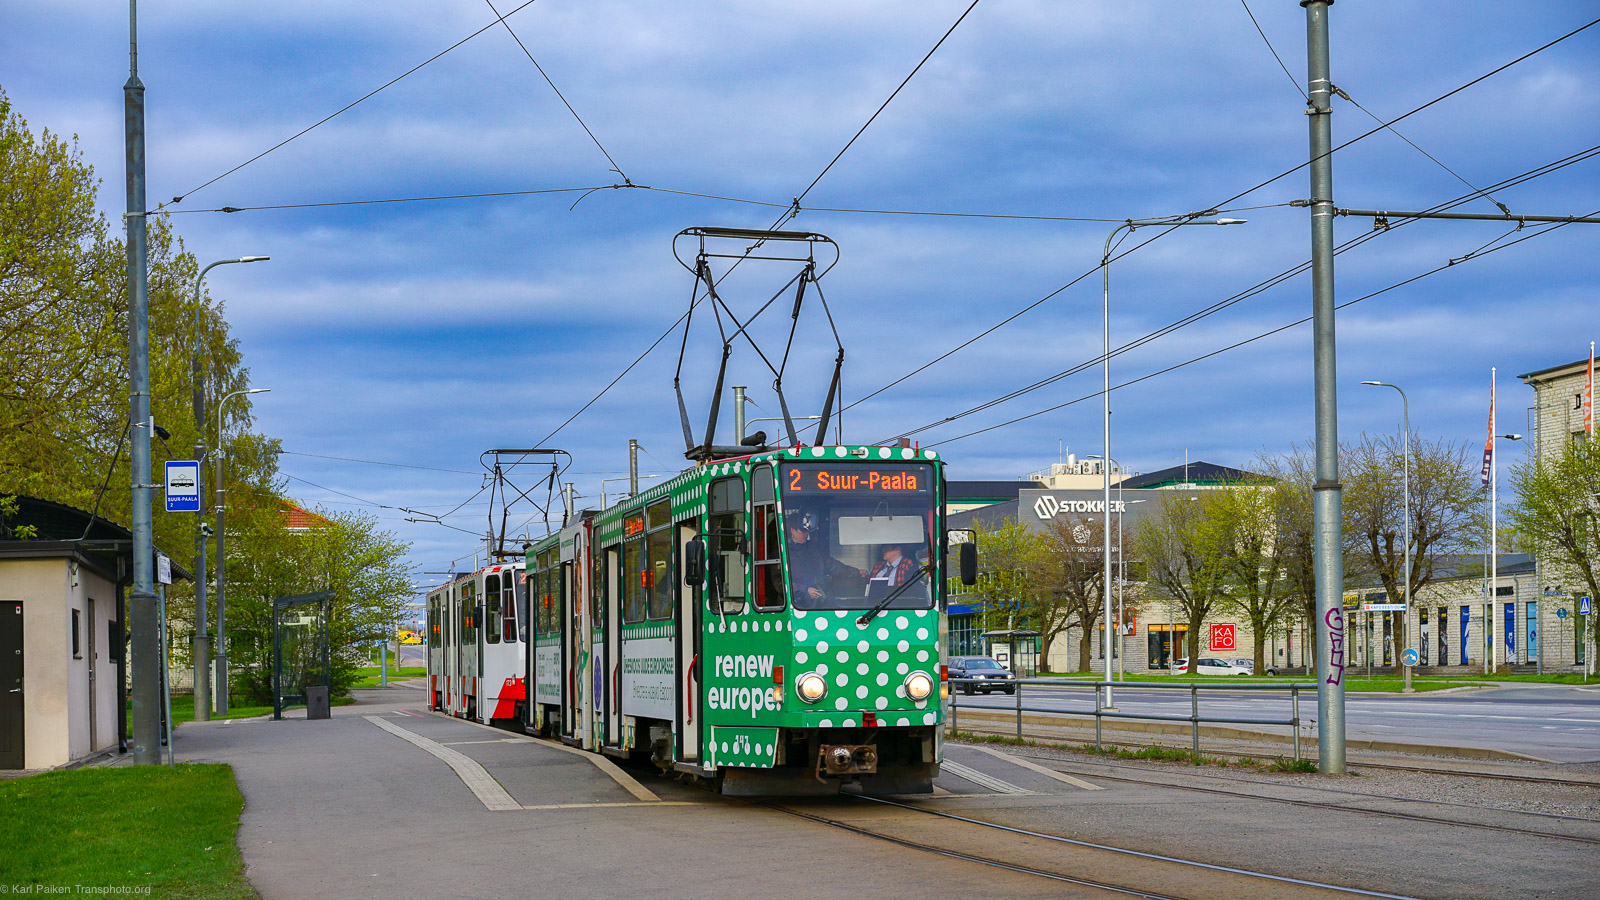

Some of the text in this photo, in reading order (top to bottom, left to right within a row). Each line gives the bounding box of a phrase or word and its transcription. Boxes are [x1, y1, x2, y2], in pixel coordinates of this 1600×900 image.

[789, 469, 917, 490] 2 Suur-Paala
[1214, 627, 1233, 637] KA
[1214, 636, 1233, 647] FO
[715, 654, 775, 678] renew
